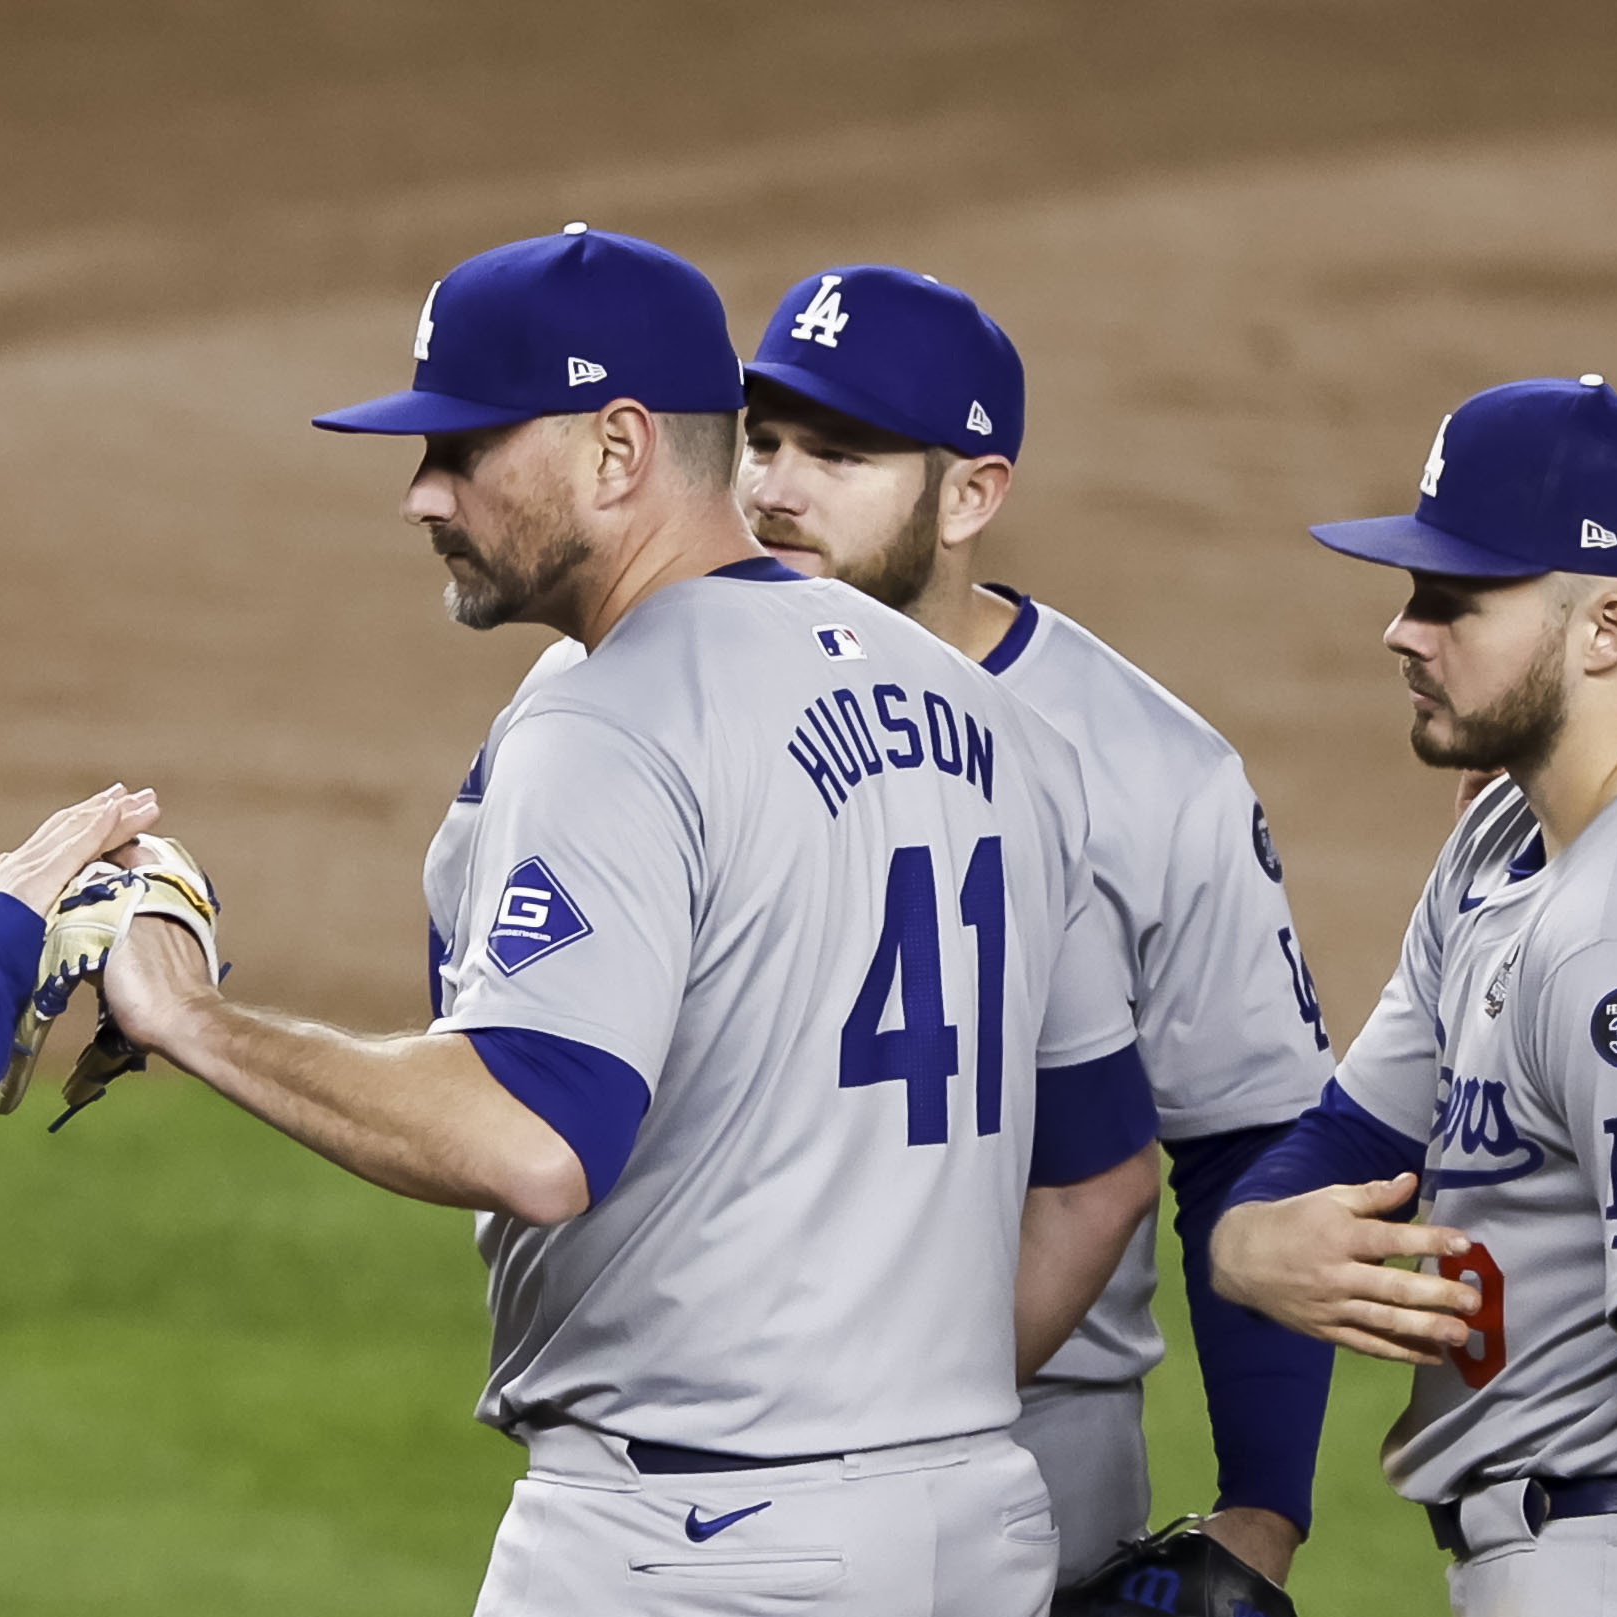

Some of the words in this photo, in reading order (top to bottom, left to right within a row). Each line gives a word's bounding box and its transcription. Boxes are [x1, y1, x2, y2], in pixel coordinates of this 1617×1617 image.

[791, 275, 850, 348] LA
[787, 683, 995, 818] HUDSON
[498, 886, 552, 928] G
[838, 835, 1008, 1147] 41
